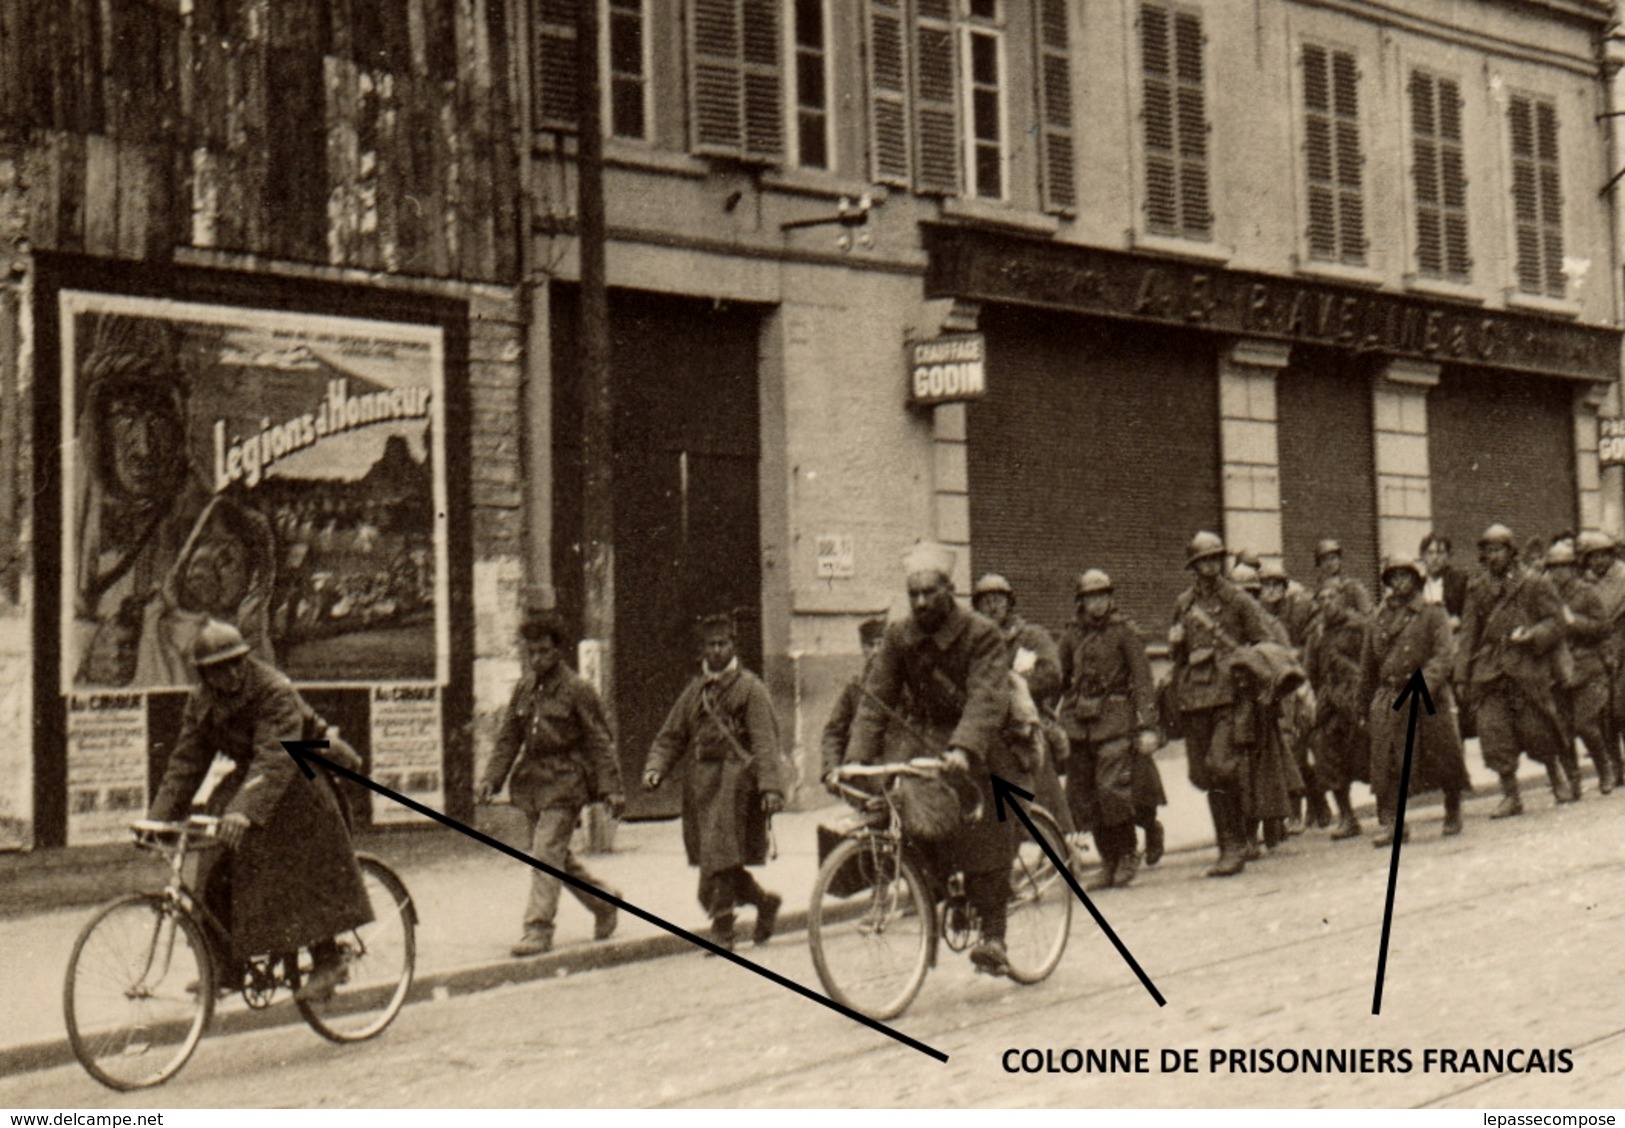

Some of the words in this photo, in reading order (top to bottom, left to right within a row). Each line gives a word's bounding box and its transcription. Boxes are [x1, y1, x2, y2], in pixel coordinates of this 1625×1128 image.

[914, 339, 983, 363] CHAUFFAGE
[913, 362, 984, 398] GODIN
[214, 413, 316, 495] Légions
